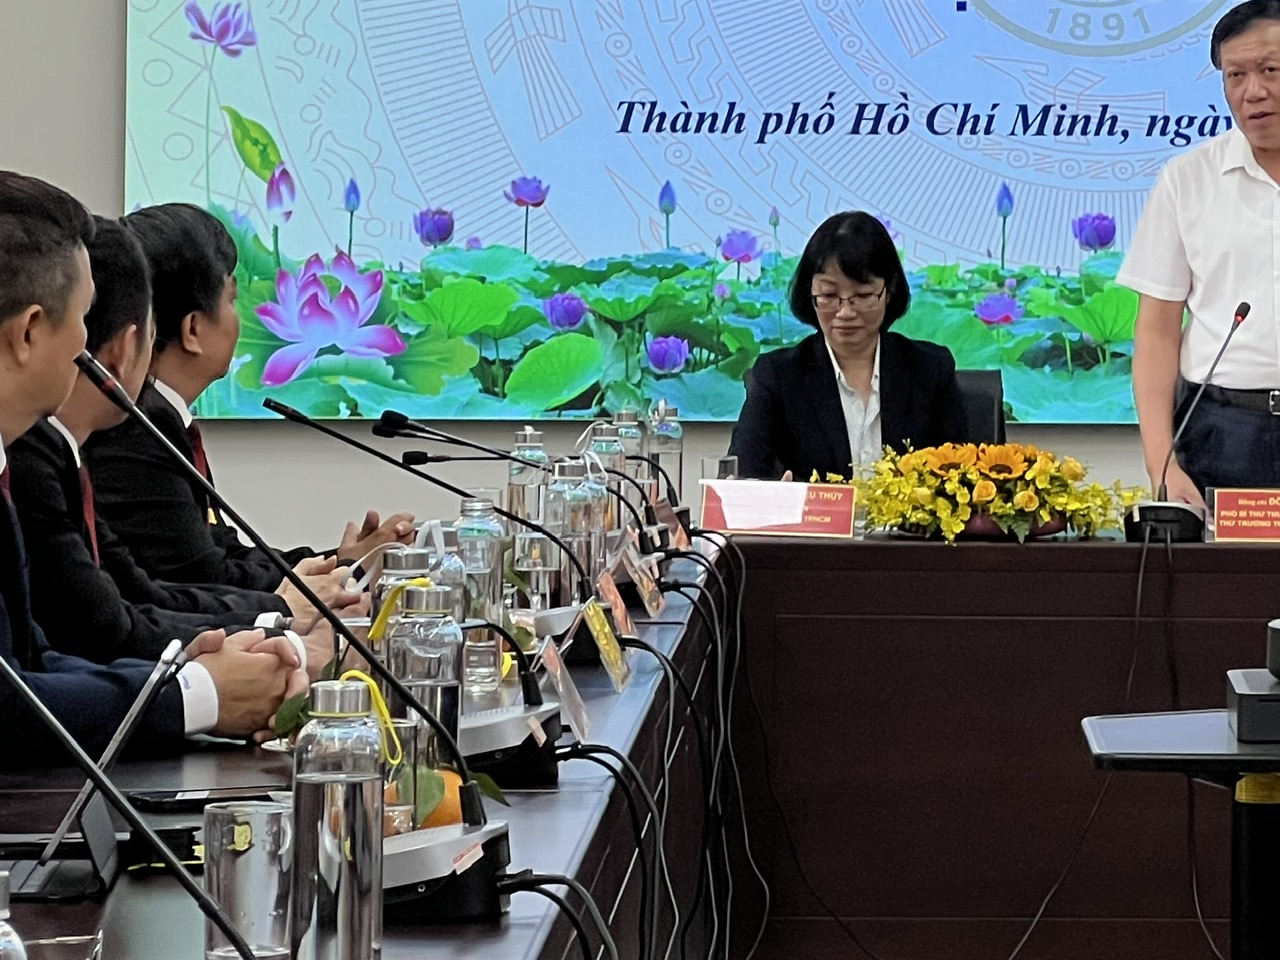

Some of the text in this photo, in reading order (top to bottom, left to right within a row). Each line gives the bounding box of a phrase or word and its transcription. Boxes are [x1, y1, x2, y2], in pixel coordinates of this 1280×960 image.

[1046, 7, 1152, 42] 1891
[615, 100, 746, 136] Thành
[753, 91, 836, 145] phố
[849, 92, 910, 136] Hồ
[926, 102, 1000, 137] Chí
[1008, 103, 1130, 145] Minh,
